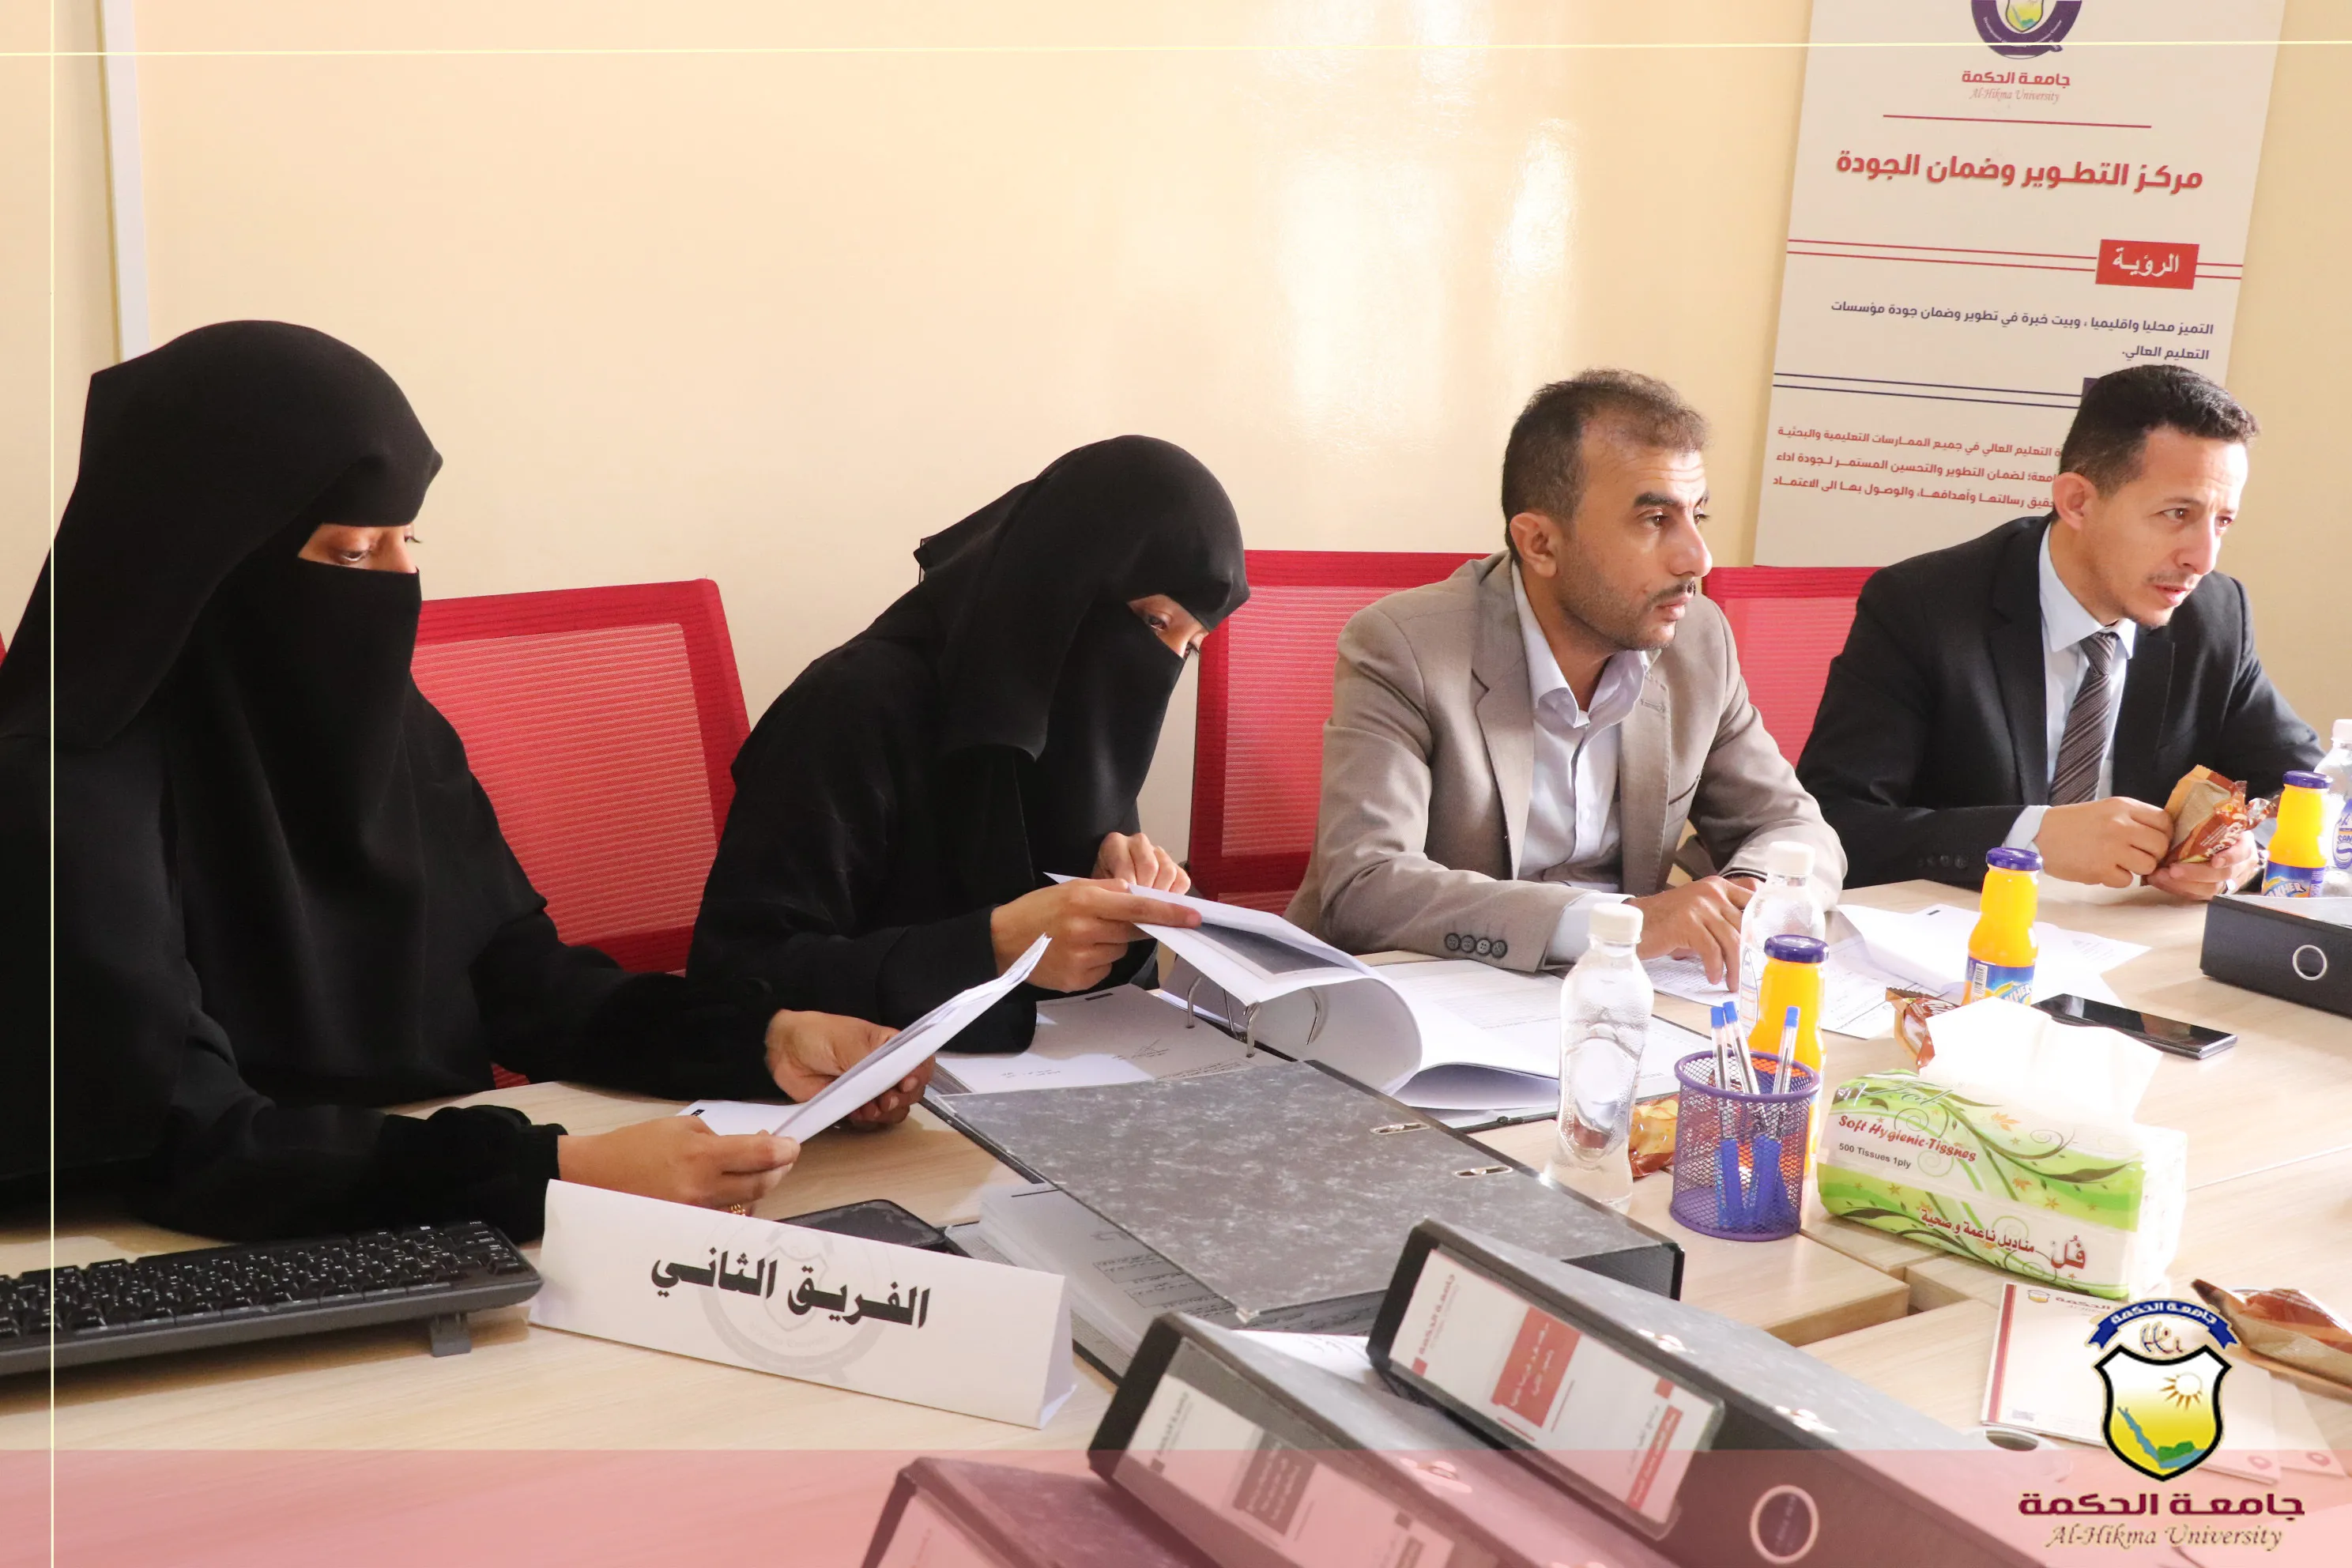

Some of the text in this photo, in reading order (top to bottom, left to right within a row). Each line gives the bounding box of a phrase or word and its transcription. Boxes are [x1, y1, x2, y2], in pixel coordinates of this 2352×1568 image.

[1962, 70, 2071, 89] جامعة الحكمة
[1969, 88, 2060, 104] Al-Hikma University
[1836, 150, 2203, 194] مركز التطوير وضمان الجودة
[2112, 247, 2180, 277] الرؤية
[1830, 300, 1885, 316] مؤسسات
[1888, 303, 1917, 318] جودة
[1920, 307, 1961, 321] وضمان
[1963, 310, 1999, 323] تطوير
[2000, 311, 2018, 328] في
[2021, 313, 2049, 326] خبرة
[2051, 315, 2080, 329] وبيت
[2090, 316, 2139, 332] واقليميا
[2143, 319, 2175, 334] محليا
[2177, 322, 2214, 336] التميز
[2164, 348, 2211, 361] التعليم
[1777, 425, 1822, 440] والبحثية
[1823, 430, 1870, 443] التعليمية
[1871, 435, 1931, 448] الممارسات
[1932, 439, 1963, 453] جميع
[1964, 442, 1980, 455] في
[1981, 443, 2013, 457] العالي
[2015, 446, 2052, 458] التعليم
[1797, 452, 1833, 466] لجودة
[1834, 458, 1888, 469] المستمر
[1890, 462, 1943, 475] والتحسين
[1945, 466, 1984, 478] التطوير
[1987, 470, 2025, 481] لضمان
[1773, 476, 1819, 488] الاعتماد
[1839, 481, 1862, 494] بها
[1864, 483, 1914, 499] والوصول
[1978, 492, 2025, 507] رسالتها
[1838, 1114, 1867, 1133] Soft
[1839, 1143, 1912, 1170] 500 Tissues 1ply
[1920, 1207, 1952, 1230] صحية
[1963, 1220, 1996, 1242] ناعمة
[1996, 1234, 2035, 1253] مناديل
[650, 1246, 932, 1329] الفريق الثاني
